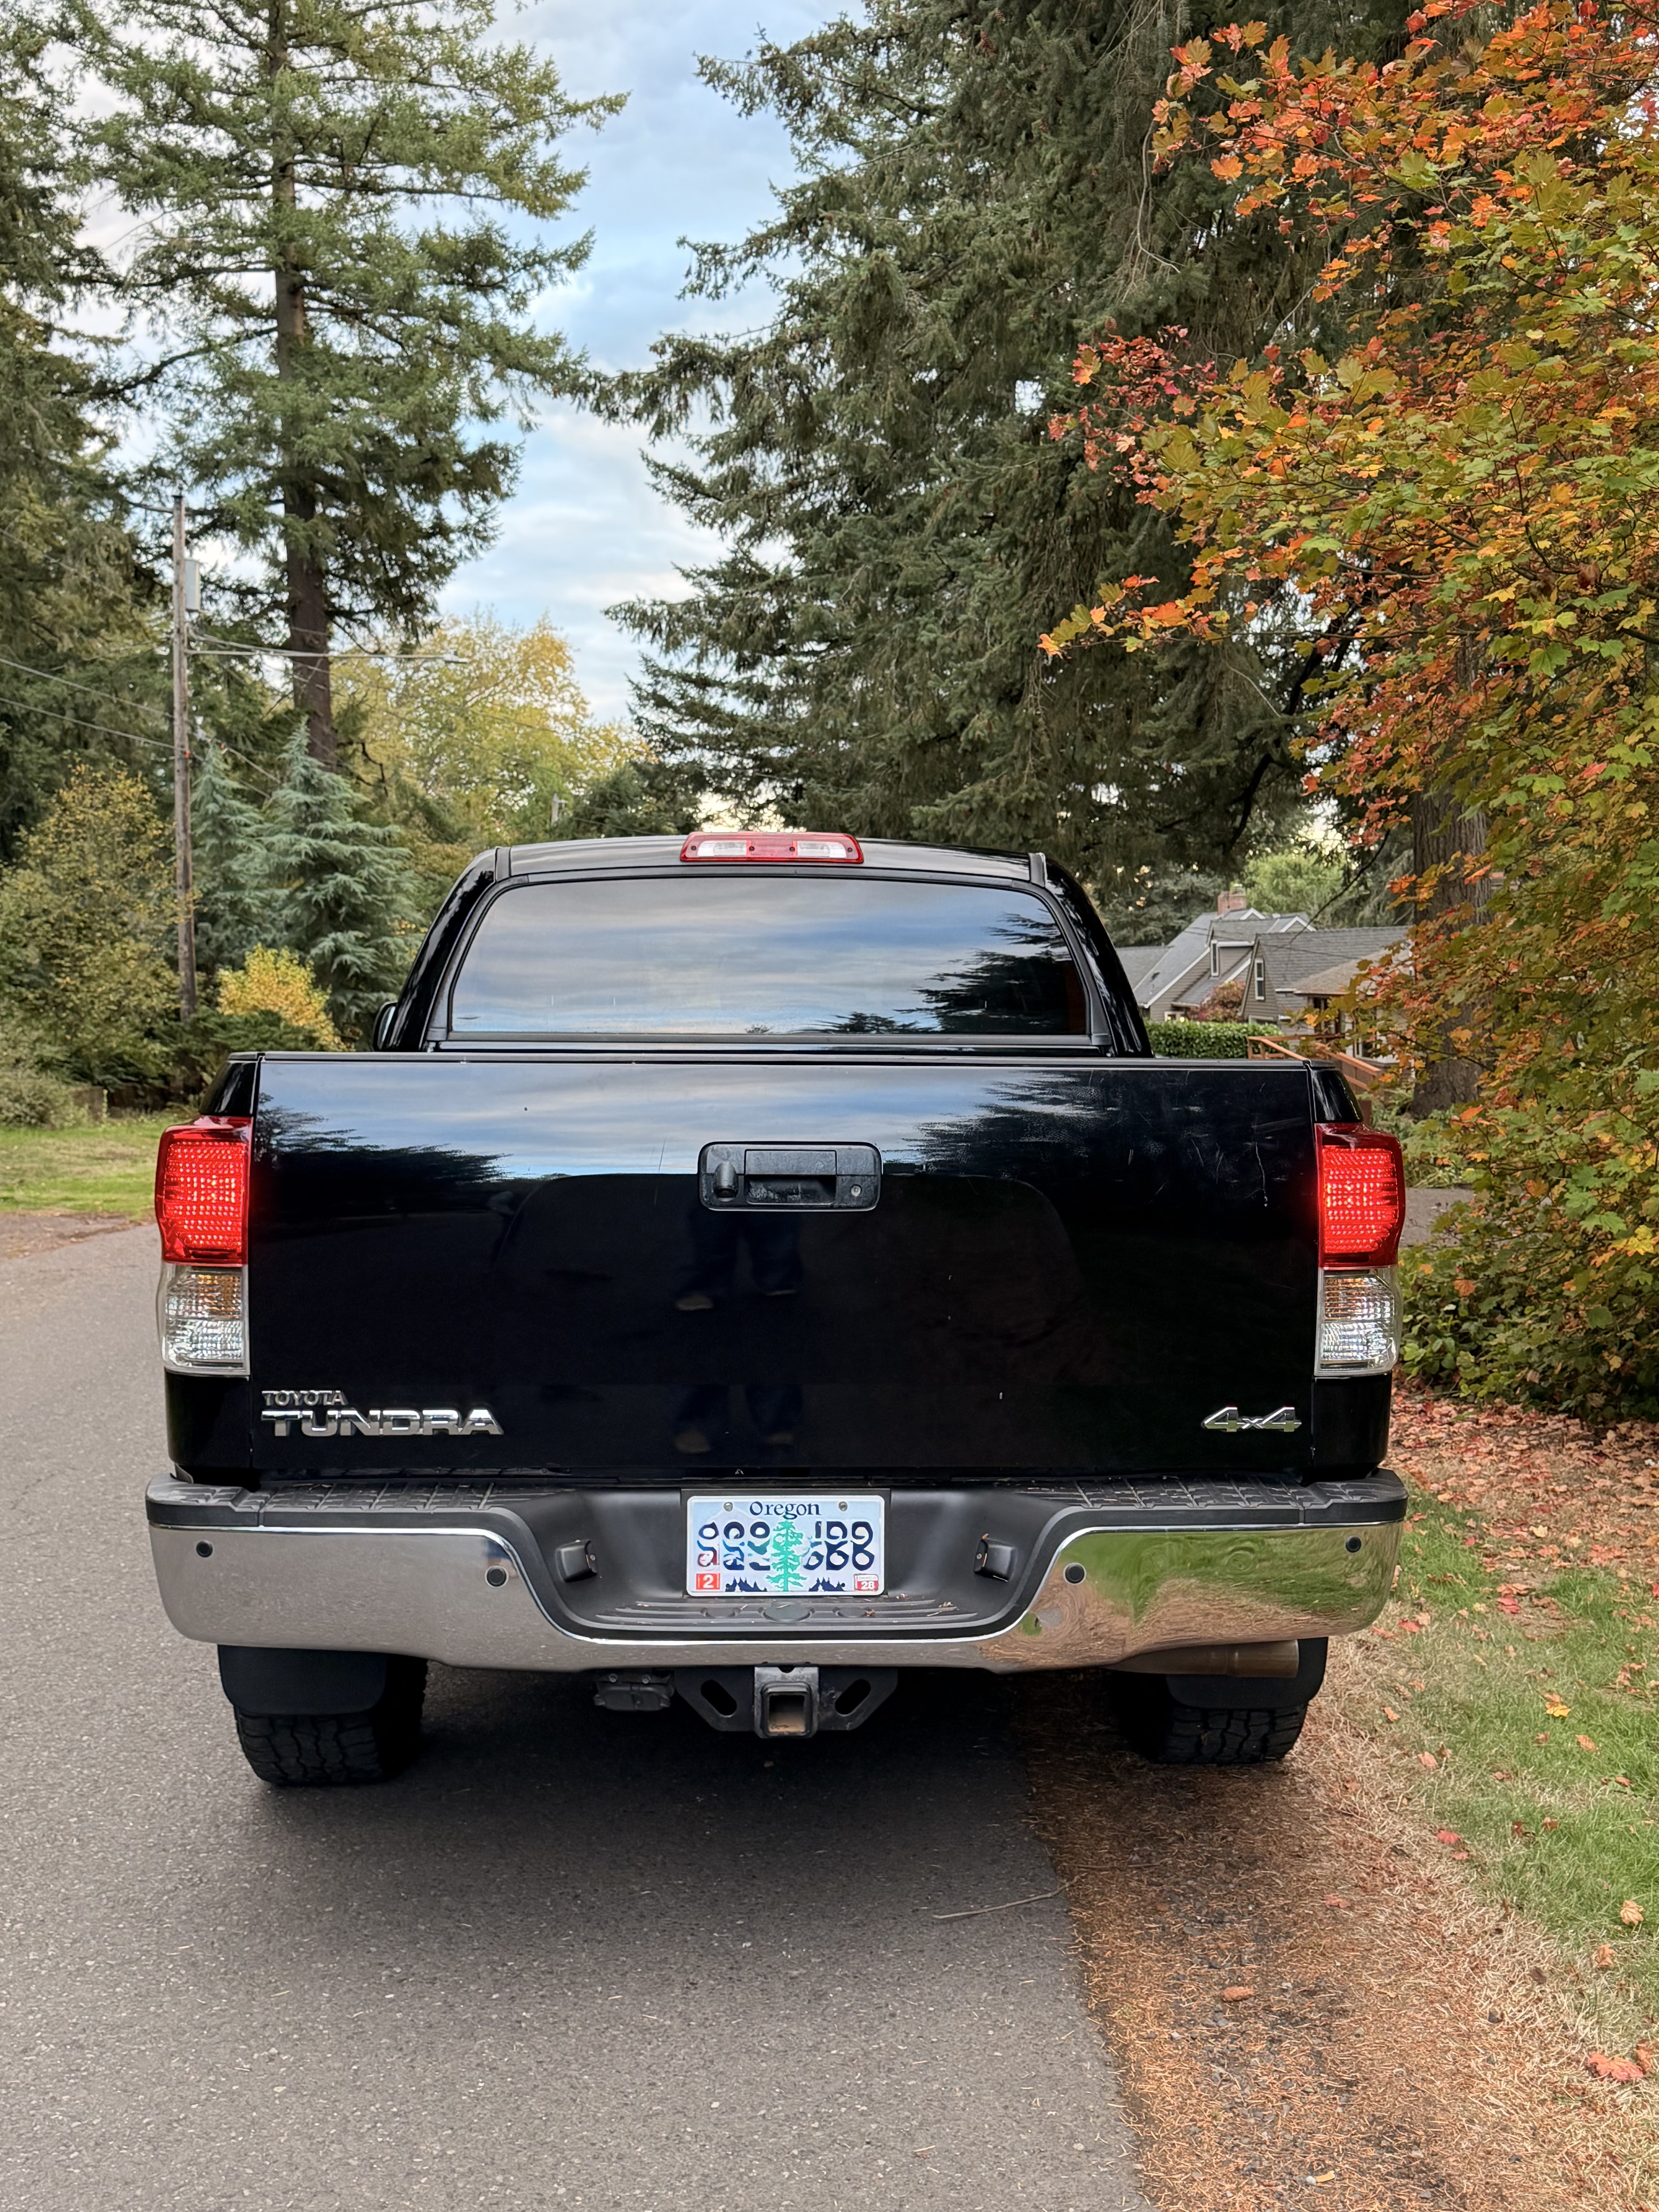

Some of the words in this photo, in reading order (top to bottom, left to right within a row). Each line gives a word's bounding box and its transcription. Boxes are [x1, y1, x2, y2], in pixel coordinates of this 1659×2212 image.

[262, 1390, 347, 1406] TOYOTA
[261, 1409, 504, 1436] TUNDRA
[749, 1501, 822, 1520] Oregon
[702, 1574, 714, 1589] 2
[861, 1581, 875, 1590] 28
